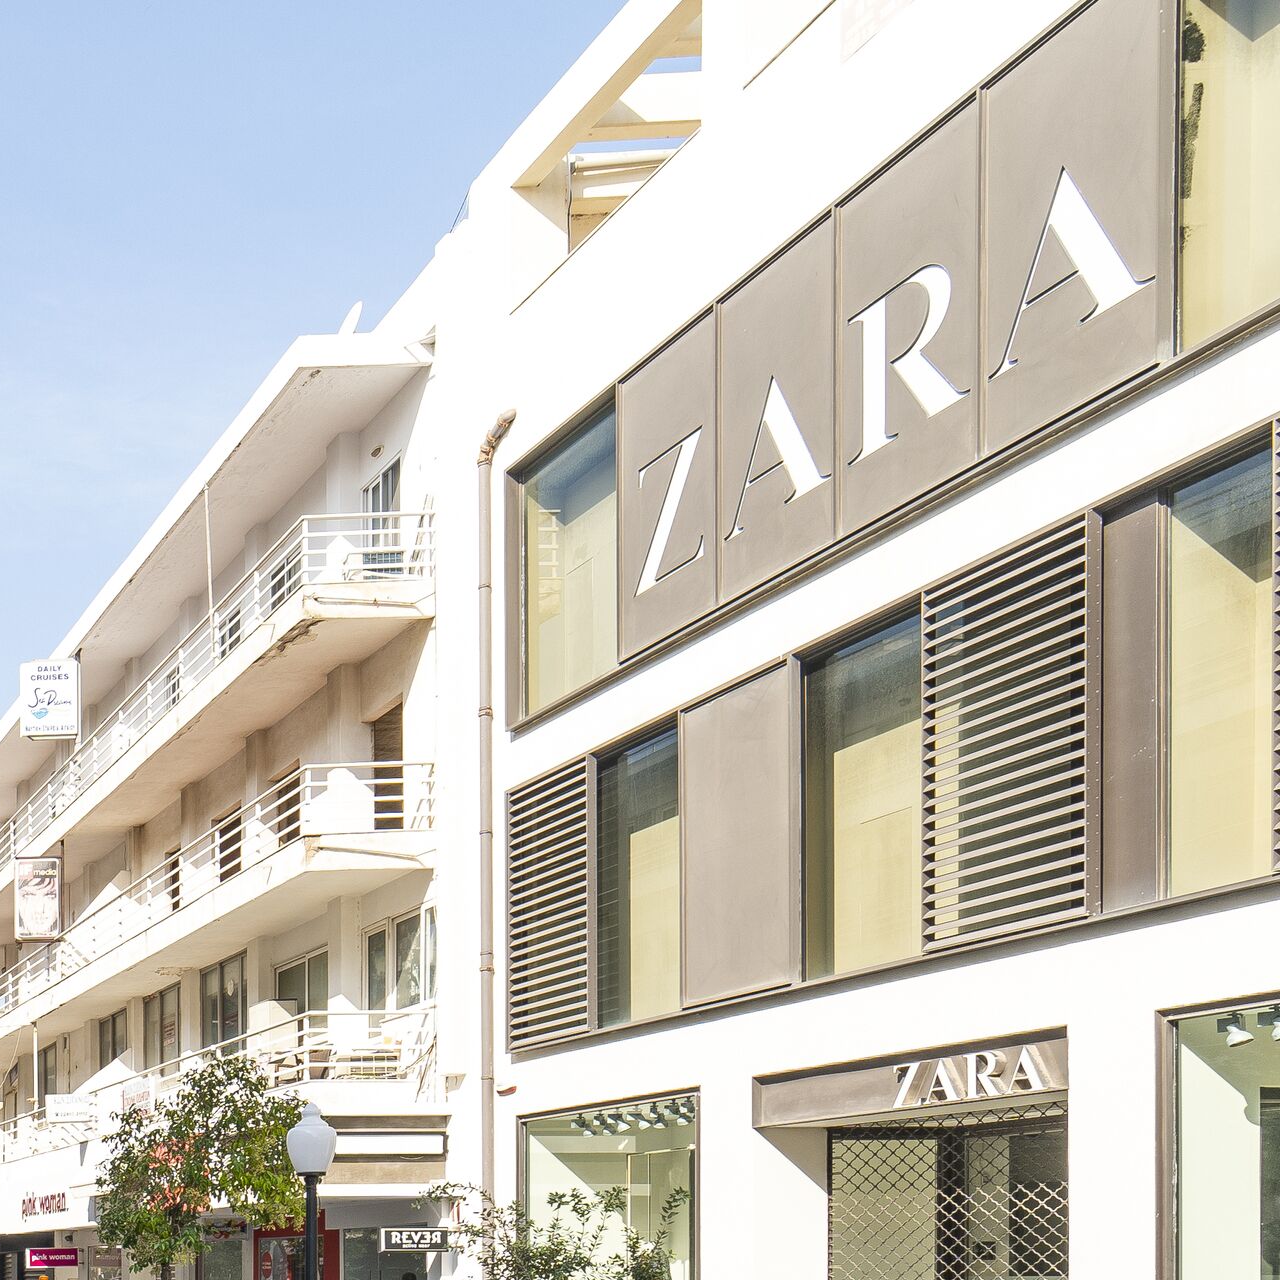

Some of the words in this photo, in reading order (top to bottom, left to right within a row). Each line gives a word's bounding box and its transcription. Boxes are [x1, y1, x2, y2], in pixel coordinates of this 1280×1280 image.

[635, 166, 1158, 598] ZARA
[30, 673, 69, 681] CRUISES
[20, 863, 33, 876] IF
[33, 868, 57, 876] media
[892, 1045, 1049, 1109] ZARA
[21, 1192, 38, 1218] pink
[40, 1191, 67, 1215] woman
[31, 1251, 48, 1262] pink
[49, 1253, 76, 1261] woman
